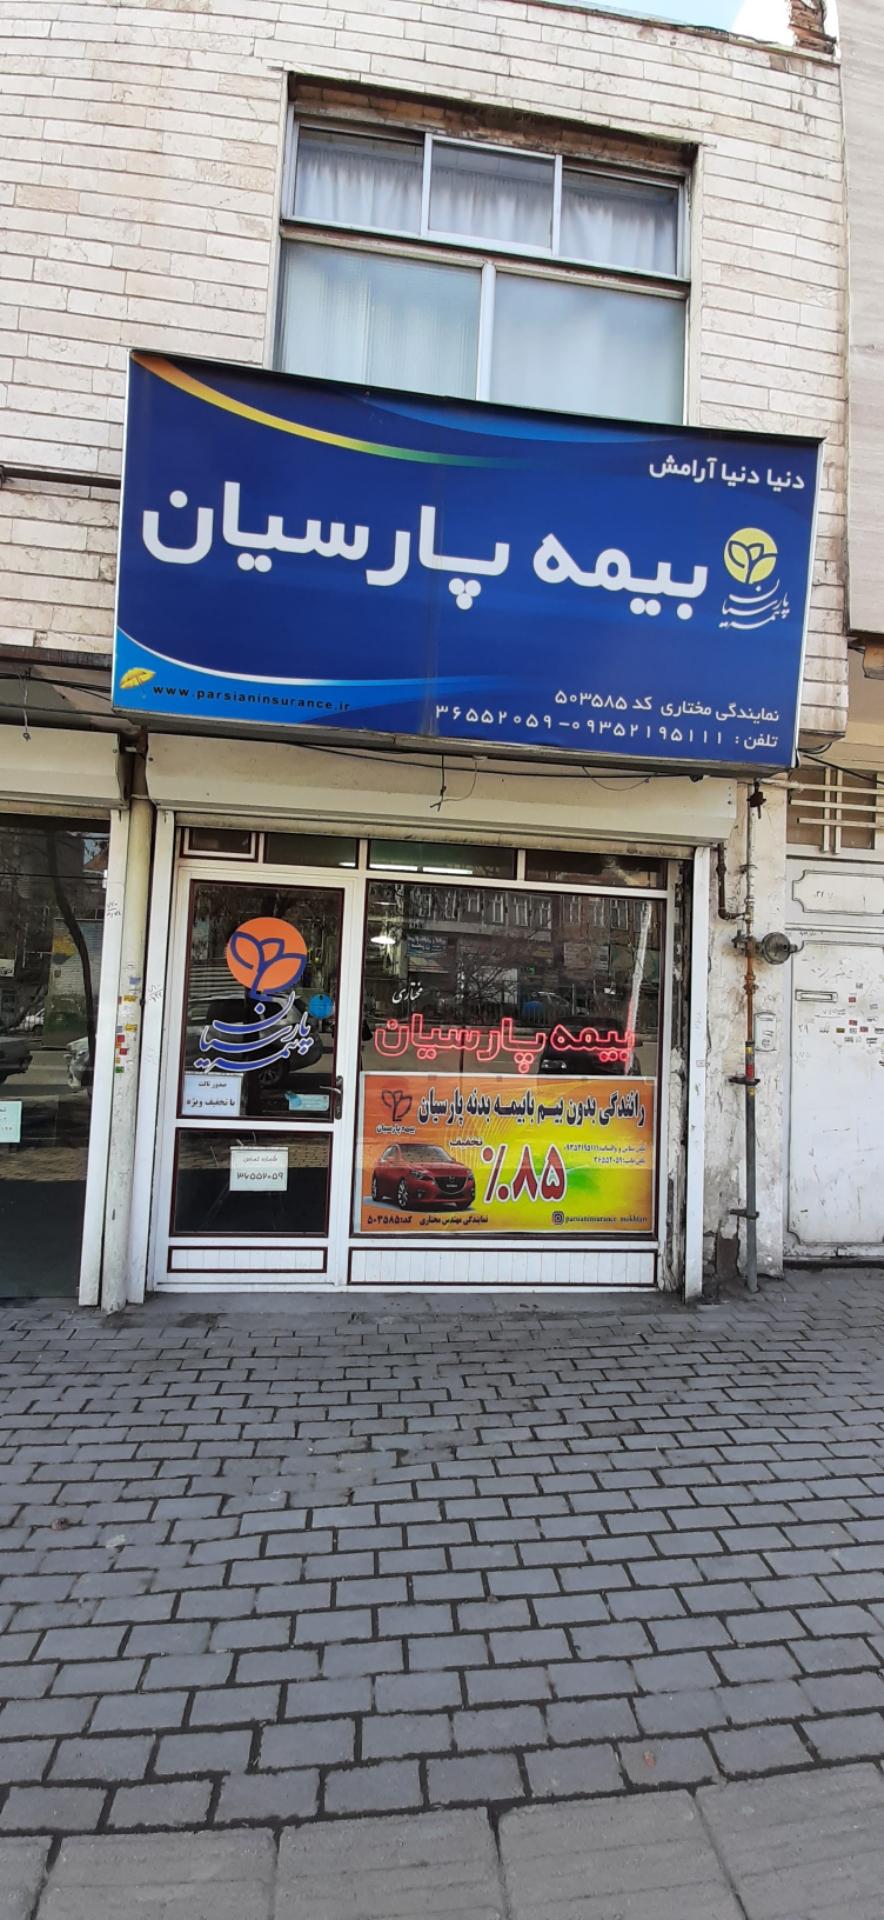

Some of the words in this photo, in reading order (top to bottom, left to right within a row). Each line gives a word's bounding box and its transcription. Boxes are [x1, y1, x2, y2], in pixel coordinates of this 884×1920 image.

[649, 454, 718, 483] آرامش
[721, 463, 760, 487] دنیا
[766, 468, 805, 492] دنیا
[142, 480, 510, 610] پارسیان
[532, 532, 709, 621] بیمه
[152, 685, 350, 711] www.parsianinsurance.ir
[554, 690, 628, 710] ۵۰۳۵۸۵
[632, 695, 653, 710] کد
[660, 700, 712, 717] مختاری
[715, 702, 780, 724] نمایندگی
[392, 982, 424, 1004] مختاری
[374, 1013, 548, 1074] پارسیان
[550, 1024, 635, 1062] بیمه
[186, 1098, 203, 1108] ویژه
[205, 1097, 228, 1106] تخفیف
[417, 1087, 464, 1127] پارسیان
[466, 1088, 491, 1123] بدنه
[537, 1096, 564, 1124] بیم
[566, 1096, 597, 1126] بدون
[599, 1090, 645, 1127] رانندگی
[449, 1137, 483, 1147] تخفیف
[463, 1215, 488, 1226] نمایندگی
